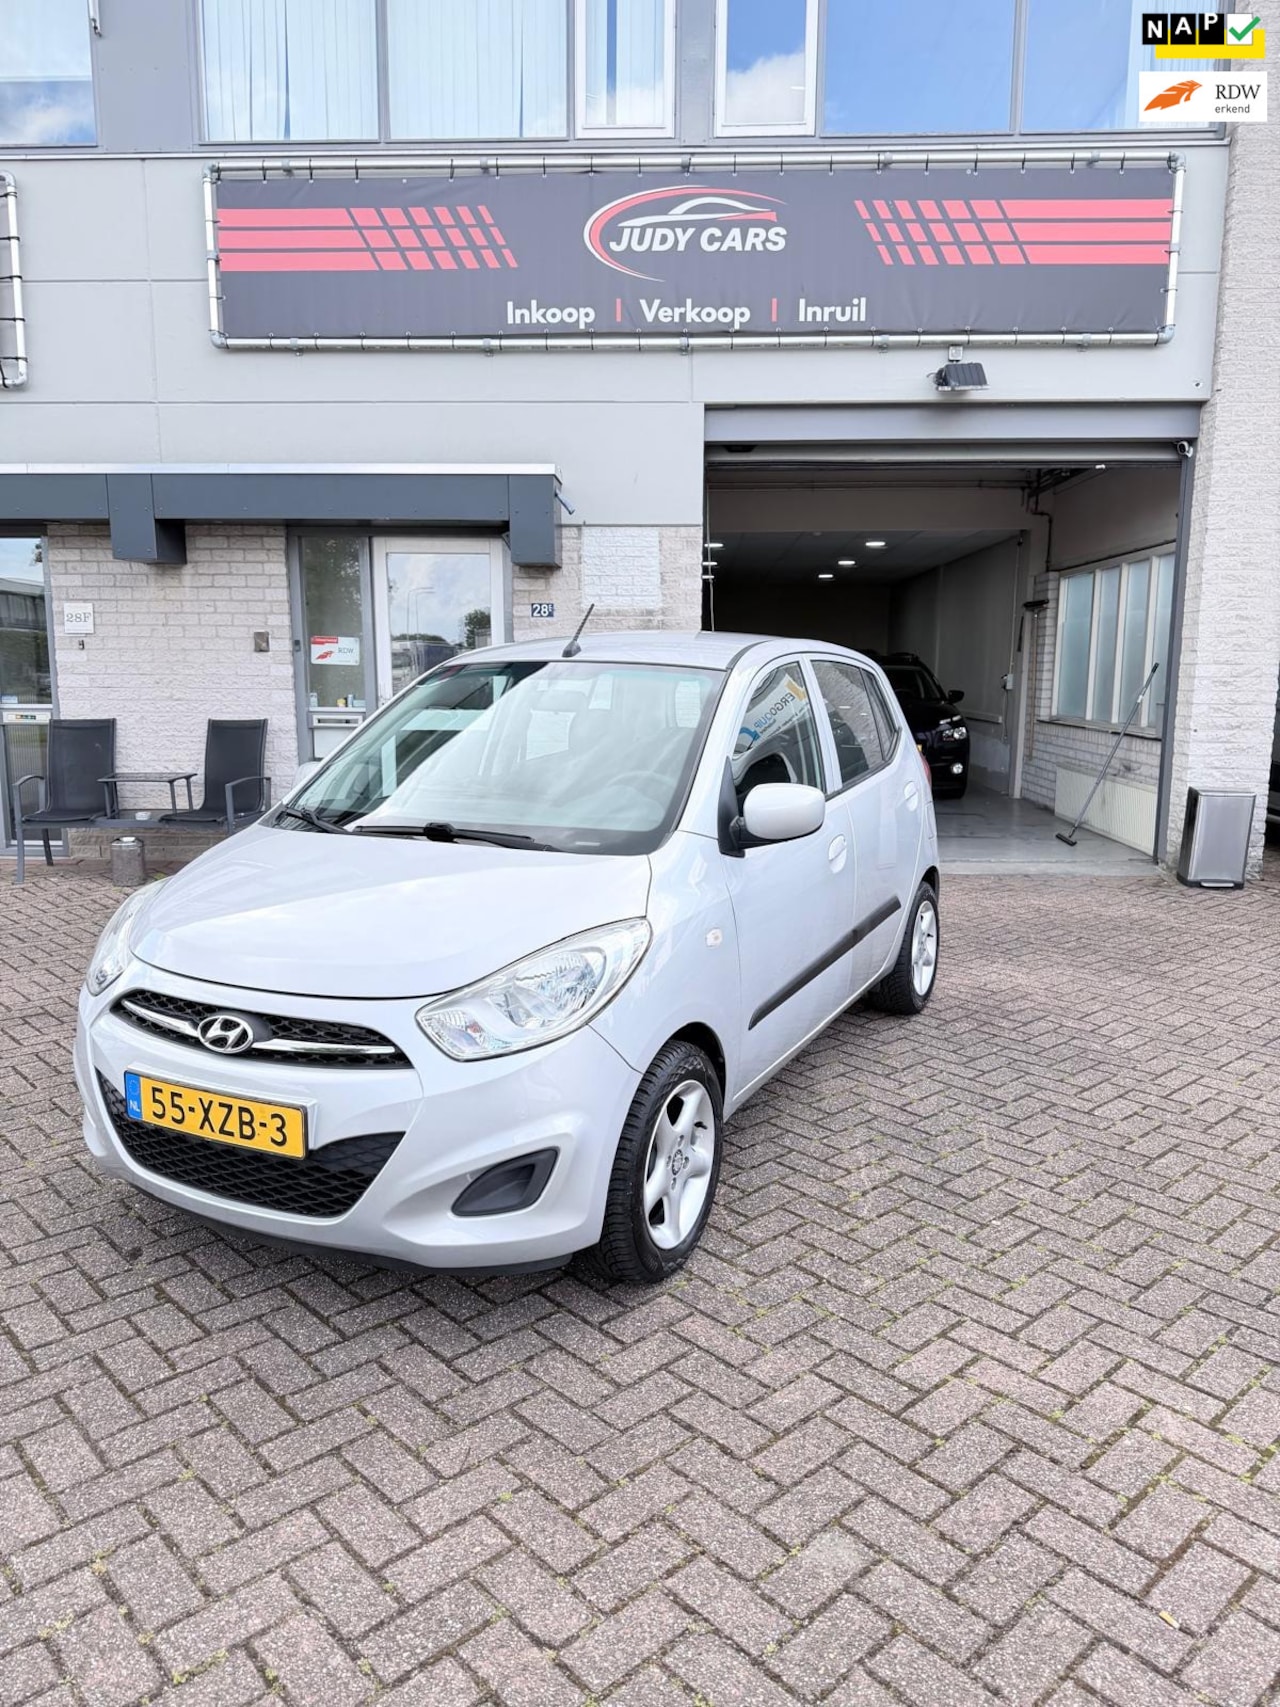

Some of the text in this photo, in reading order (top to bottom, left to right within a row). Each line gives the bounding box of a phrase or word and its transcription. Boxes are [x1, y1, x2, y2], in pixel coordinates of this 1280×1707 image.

[609, 227, 787, 252] JUDY CARS
[507, 297, 866, 329] Inkoop Verkoop Inruil
[66, 612, 92, 623] 28F
[129, 1099, 141, 1113] NL
[151, 1086, 288, 1147] 55-XZB-3
